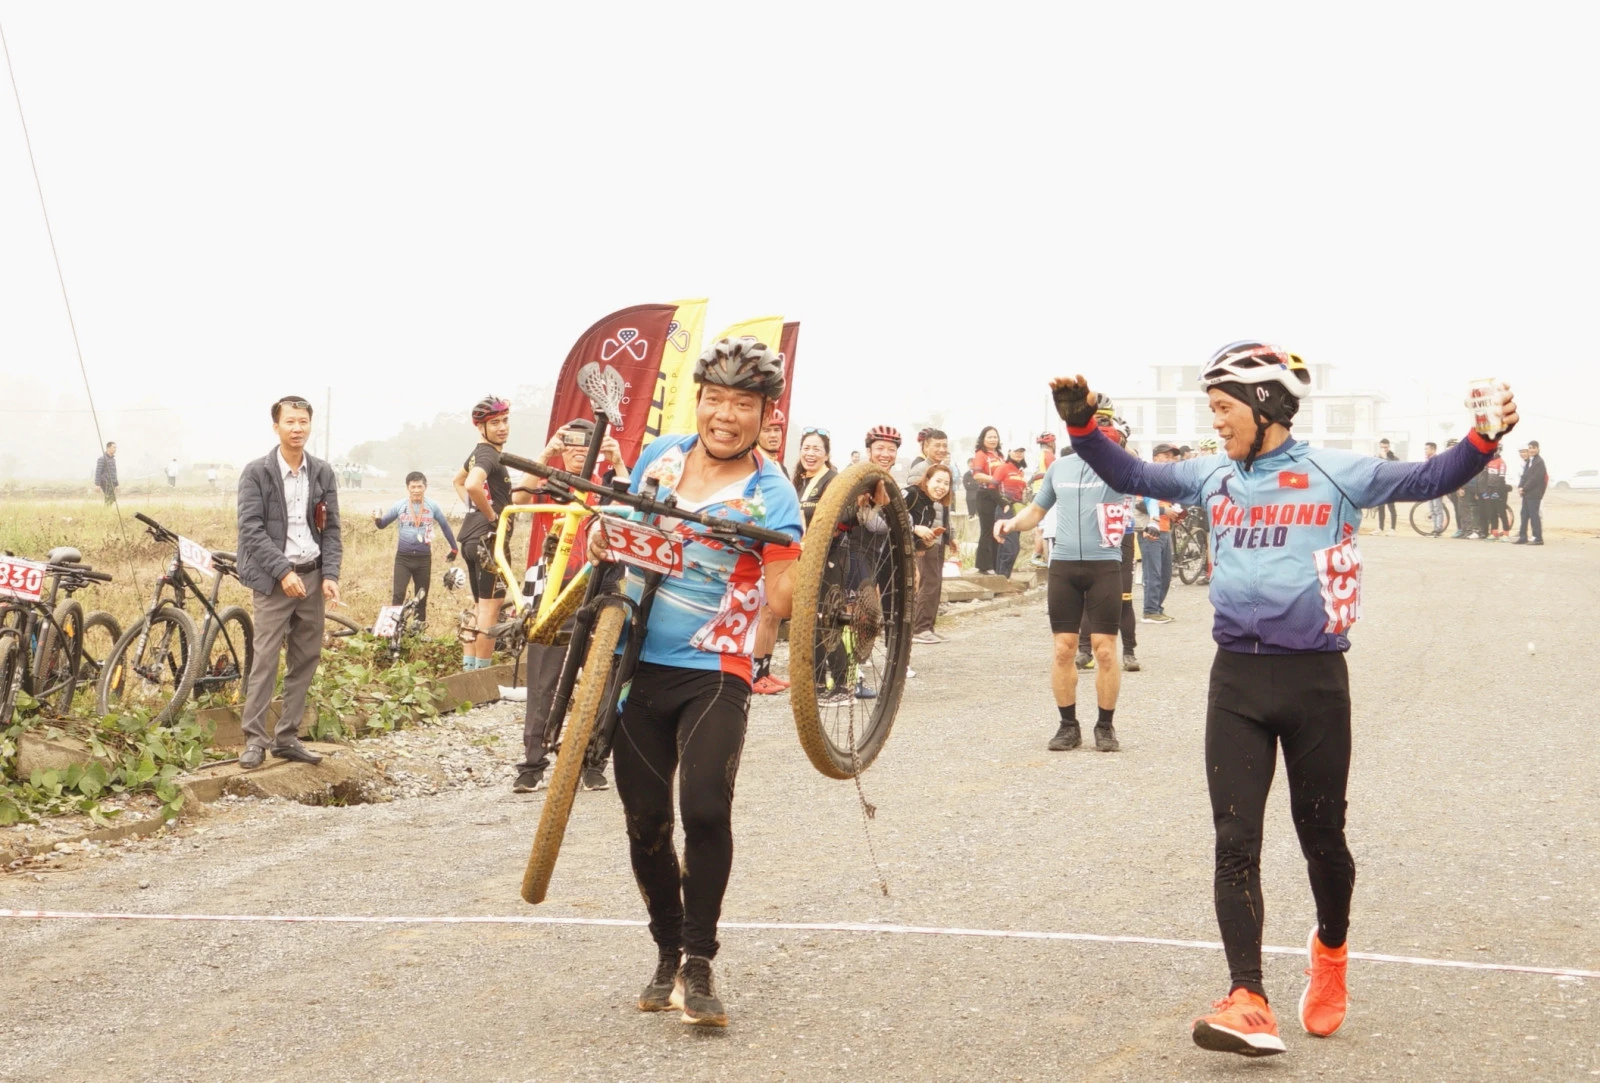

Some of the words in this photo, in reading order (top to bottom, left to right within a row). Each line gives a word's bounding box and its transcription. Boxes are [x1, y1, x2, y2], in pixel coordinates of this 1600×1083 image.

[1211, 498, 1244, 527] HAI
[1250, 504, 1332, 527] PHONG
[604, 523, 680, 565] 536
[1233, 526, 1288, 548] VELO
[703, 589, 760, 653] 536
